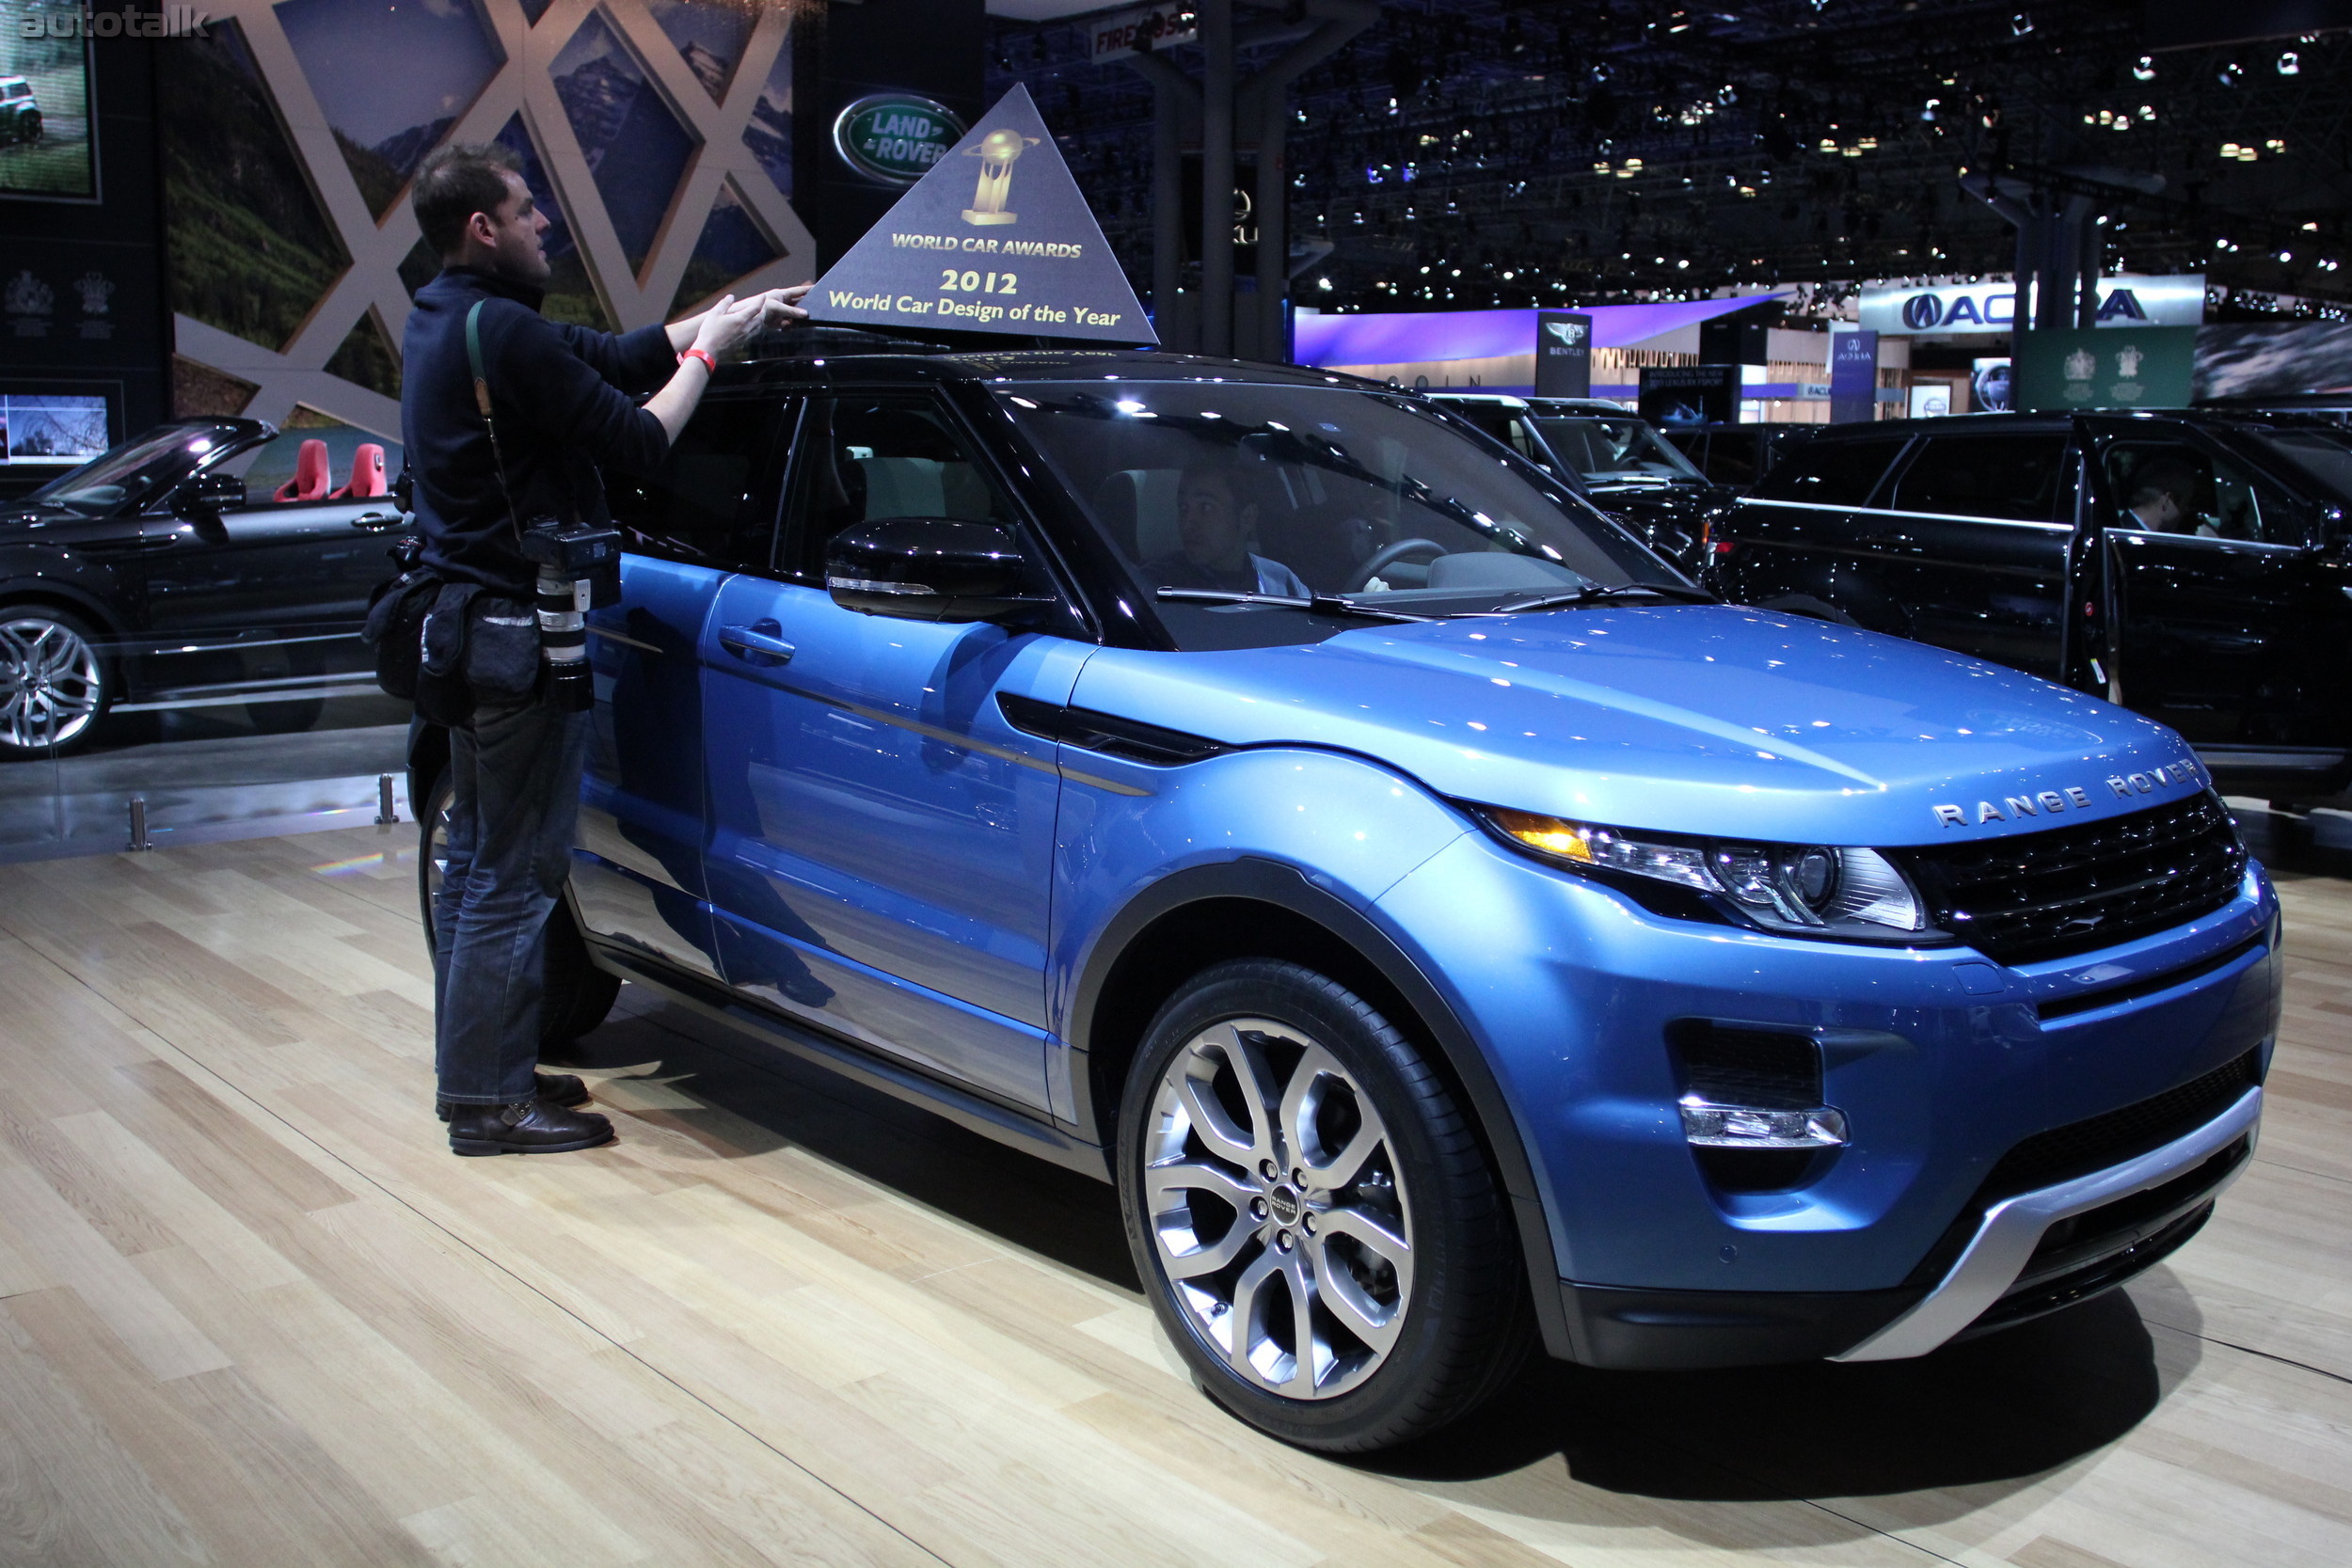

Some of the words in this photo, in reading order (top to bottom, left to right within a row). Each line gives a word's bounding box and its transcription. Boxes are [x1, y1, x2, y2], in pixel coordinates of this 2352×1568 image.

[1095, 24, 1136, 55] FIRE
[872, 113, 930, 139] LAND
[875, 137, 948, 164] ROVER
[892, 233, 959, 252] WORLD
[961, 237, 998, 253] CAR
[1001, 240, 1082, 259] AWARDS
[939, 269, 1018, 294] 2012
[829, 290, 892, 311] World
[897, 294, 933, 315] Car
[937, 297, 1003, 323] Design
[1009, 303, 1033, 321] of
[1034, 305, 1066, 324] the
[1073, 307, 1120, 326] Year
[1549, 347, 1585, 356] BENTLEY
[1931, 785, 2091, 828] RANGE
[2105, 757, 2201, 799] ROVER
[1271, 1196, 1295, 1210] RANGE
[1271, 1200, 1295, 1214] ROVER
